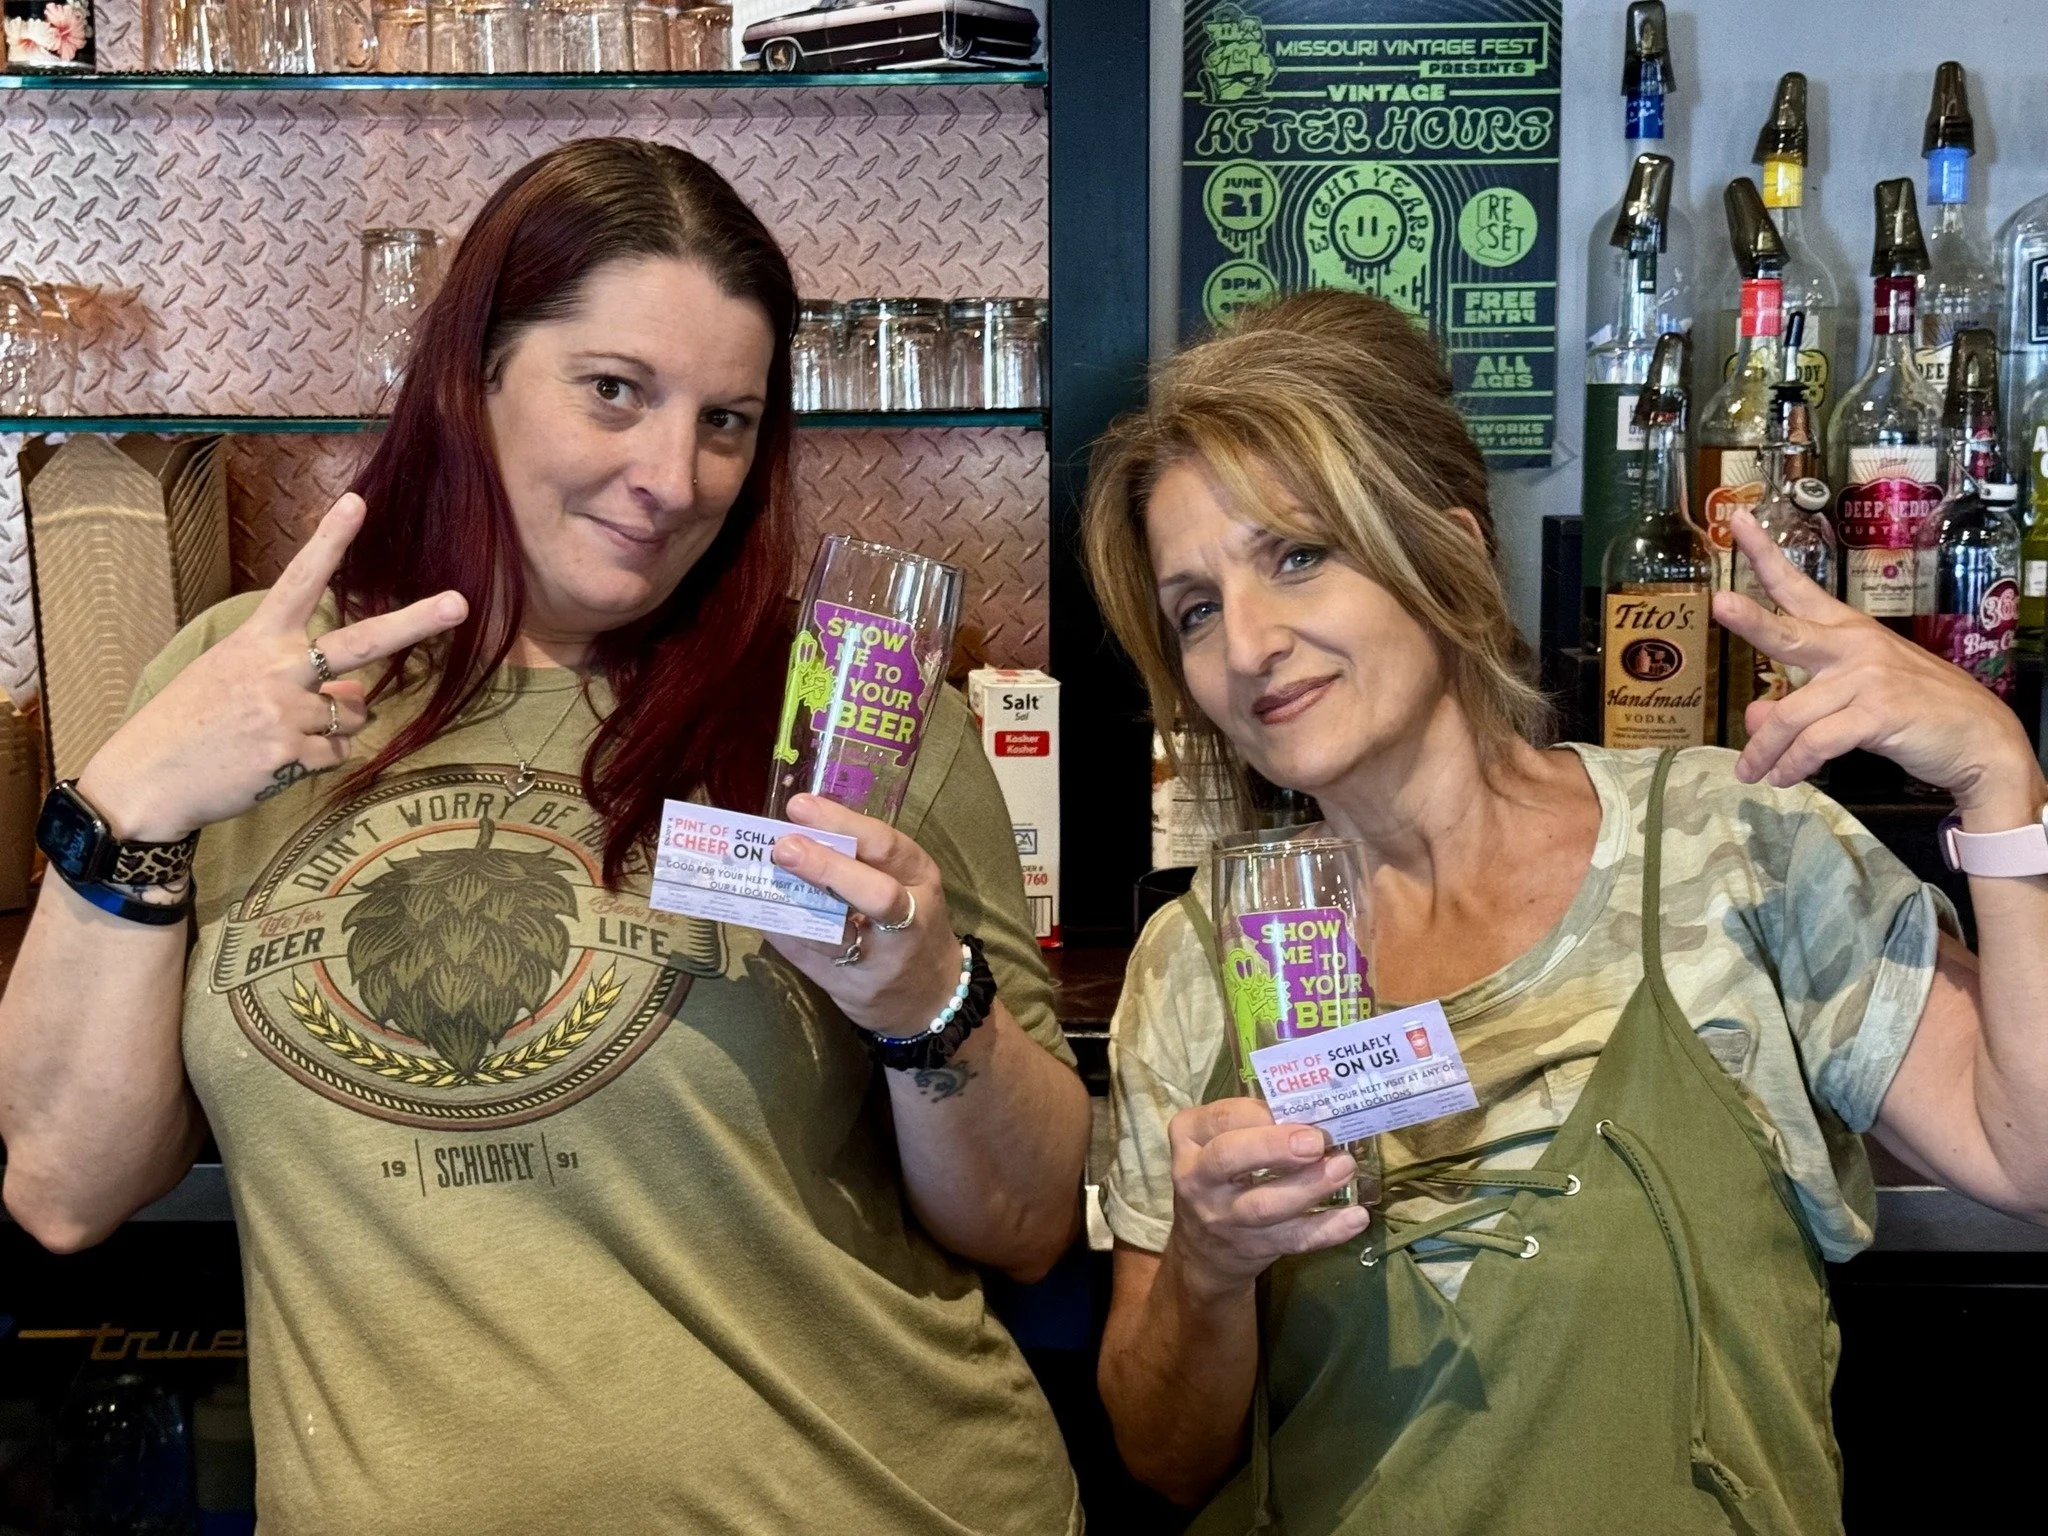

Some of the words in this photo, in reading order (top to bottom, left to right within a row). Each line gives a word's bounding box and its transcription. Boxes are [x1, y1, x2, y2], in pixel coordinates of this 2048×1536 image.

[1276, 40, 1378, 57] MISSOURI
[1383, 39, 1477, 56] VINTAGE
[1481, 38, 1538, 55] FEST
[1428, 62, 1526, 75] PRESENTS
[1327, 84, 1446, 102] VINTAGE
[1195, 107, 1371, 155] AFTER
[1376, 106, 1554, 154] HOURS
[1223, 177, 1264, 189] JUNE
[1221, 193, 1263, 218] 21
[1308, 170, 1360, 254] EIGHT
[1487, 194, 1513, 223] RE
[1486, 222, 1525, 252] SET
[1465, 291, 1537, 309] FREE
[1464, 308, 1536, 325] ENTRY
[1475, 356, 1532, 374] ALL
[1472, 374, 1534, 389] AGES
[1500, 437, 1544, 446] LOUIS
[1844, 500, 1886, 518] DEEP
[1615, 601, 1694, 630] Tito's
[828, 617, 909, 653] SHOW
[834, 641, 872, 667] ME
[874, 662, 902, 684] TO
[849, 677, 913, 711] YOUR
[1002, 693, 1040, 711] Salt
[1606, 686, 1702, 708] Handmade
[835, 700, 917, 744] BEER
[1624, 713, 1678, 724] VODKA
[675, 817, 706, 833] PINT
[710, 824, 729, 837] OF
[735, 828, 776, 847] SCHLA
[292, 820, 382, 892] DON'T
[396, 792, 517, 828] WORRY
[528, 801, 580, 832] BE
[673, 832, 730, 857] CHEER
[733, 844, 764, 863] ON
[666, 860, 695, 873] GOOD
[696, 865, 716, 877] FOR
[718, 869, 744, 881] YOUR
[745, 874, 769, 887] NEXT
[770, 879, 791, 891] VISIT
[794, 884, 806, 893] AT
[709, 880, 730, 893] OUR
[739, 886, 791, 903] LOCATIONS
[598, 916, 672, 960] LIFE
[1260, 918, 1342, 945] SHOW
[244, 927, 325, 977] BEER
[1281, 945, 1314, 965] ME
[1318, 952, 1348, 972] TO
[1299, 973, 1363, 996] YOUR
[1294, 997, 1372, 1029] BEER
[1327, 1033, 1393, 1063] SCHLAFLY
[1269, 1059, 1300, 1078] PINT
[1303, 1053, 1323, 1068] OF
[1335, 1056, 1366, 1079] ON
[1369, 1046, 1401, 1070] US!
[1276, 1066, 1332, 1094] CHEER
[1282, 1102, 1311, 1117] GOOD
[1312, 1097, 1331, 1108] FOR
[1332, 1089, 1359, 1102] YOUR
[1360, 1081, 1382, 1095] NEXT
[1383, 1075, 1405, 1089] VISIT
[1408, 1073, 1420, 1083] AT
[1421, 1067, 1441, 1080] ANY
[1442, 1063, 1456, 1073] OF
[1331, 1104, 1352, 1117] OUR
[1361, 1088, 1413, 1108] LOCATIONS
[380, 1160, 408, 1178] 19
[434, 1141, 534, 1188] SCHLAFLY
[555, 1151, 580, 1169] 91
[90, 1322, 247, 1360] true
